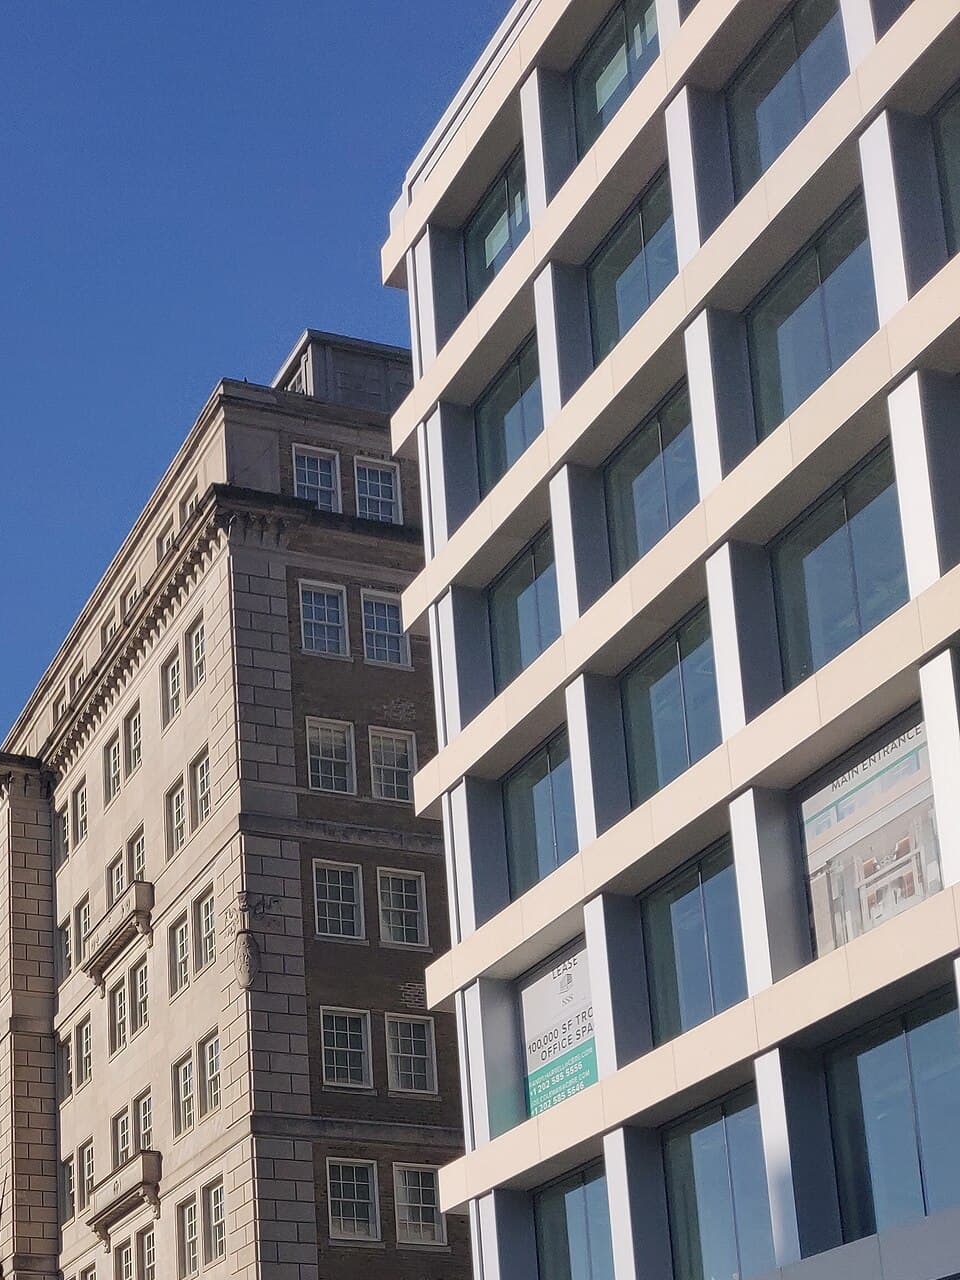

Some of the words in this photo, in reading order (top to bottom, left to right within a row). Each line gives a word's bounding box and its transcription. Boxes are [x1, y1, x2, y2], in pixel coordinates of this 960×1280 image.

[832, 767, 860, 792] MAIN
[862, 726, 922, 771] ENTRANCE
[528, 1028, 559, 1054] 100,000
[562, 1019, 573, 1034] SF
[540, 1034, 573, 1061] OFFICE
